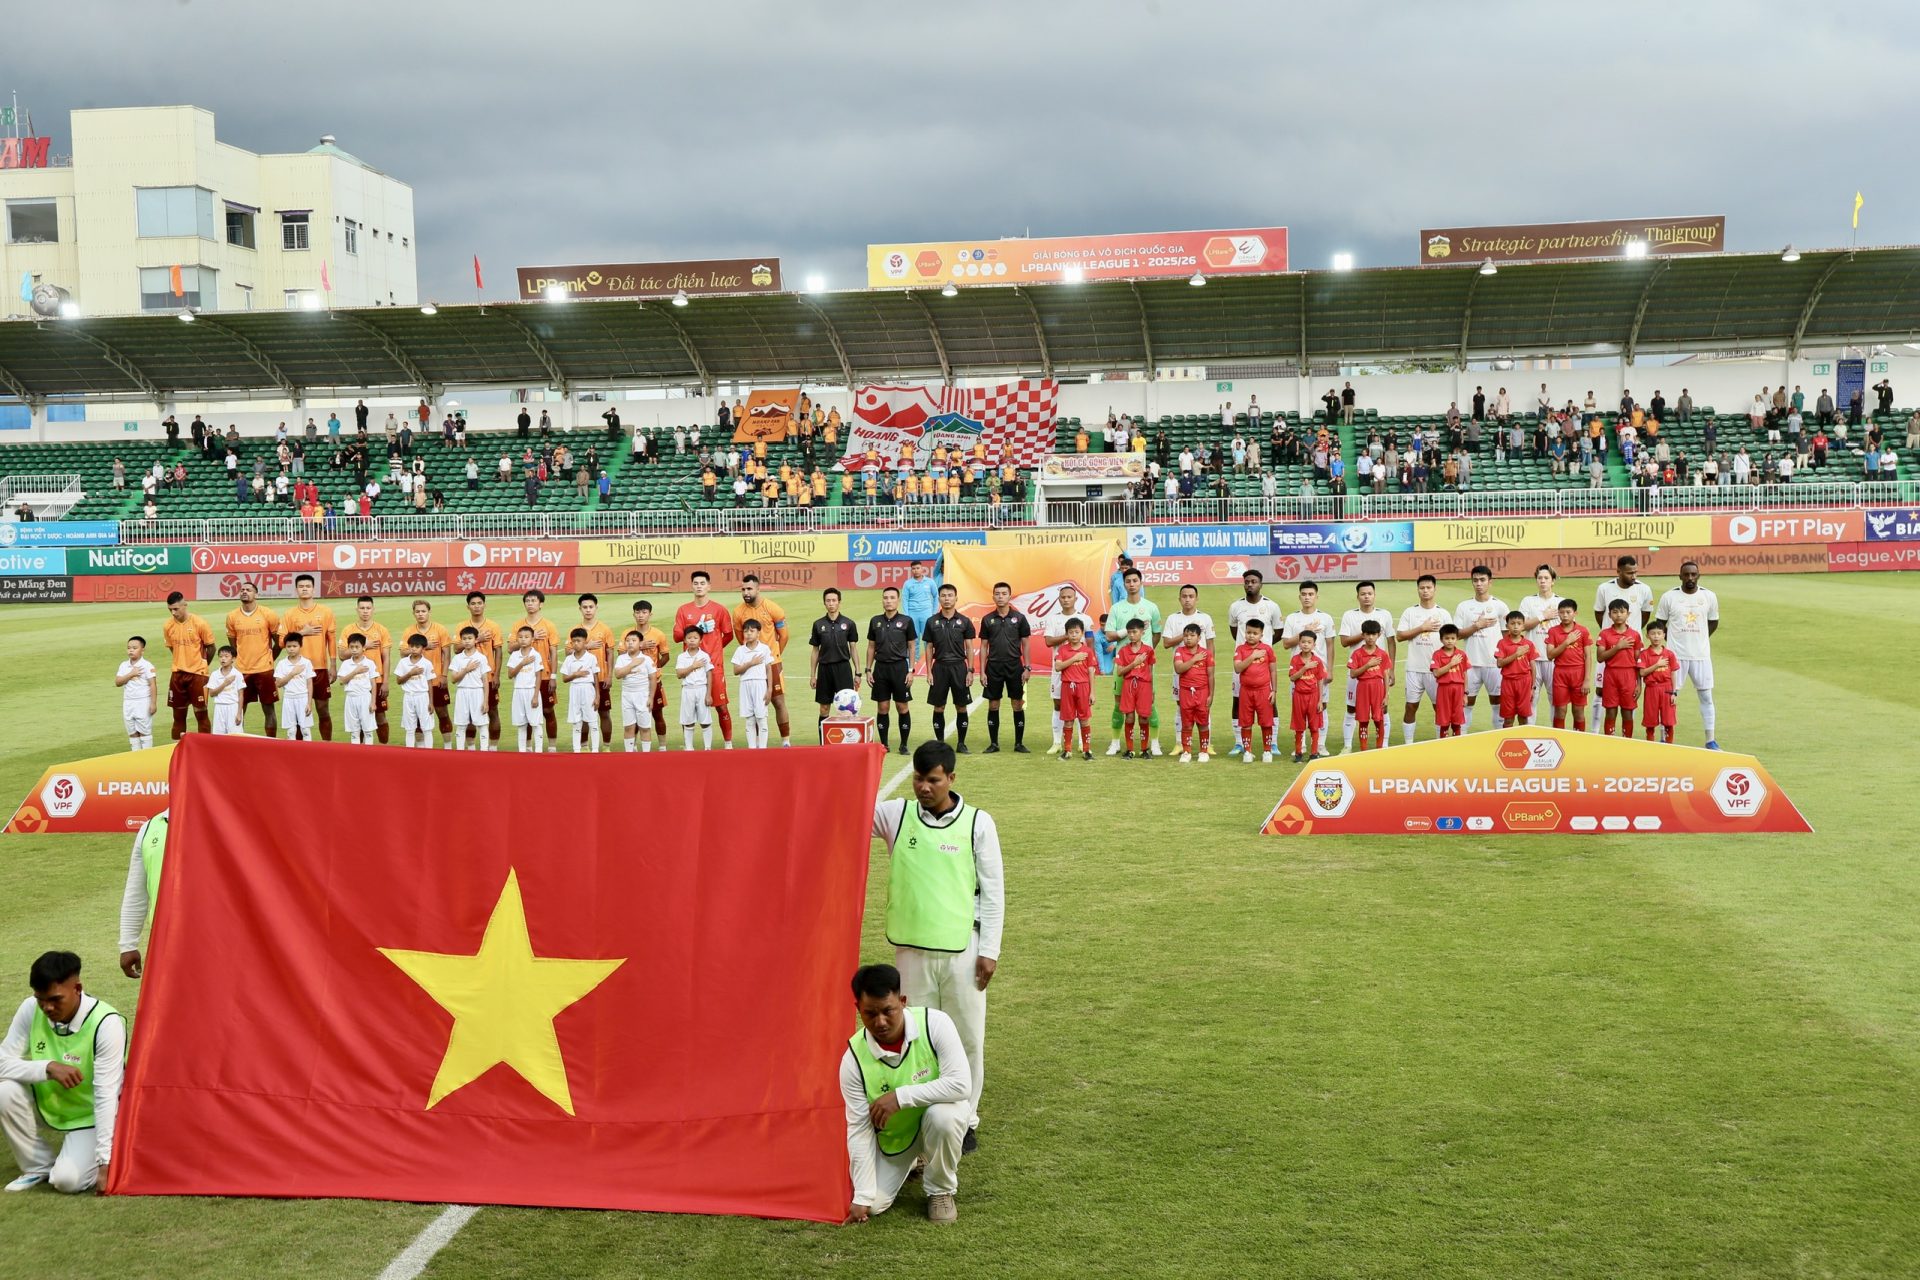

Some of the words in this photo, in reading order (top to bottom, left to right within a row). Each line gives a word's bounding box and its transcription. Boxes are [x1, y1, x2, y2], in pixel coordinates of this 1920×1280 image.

[1644, 225, 1716, 243] Thaigroup
[1083, 248, 1095, 257] ĐÁ
[1099, 247, 1111, 256] VÔ
[1115, 248, 1136, 256] ĐỊCH
[1139, 244, 1166, 255] QUỐC
[1168, 246, 1184, 254] GIA
[1459, 236, 1535, 255] Strategic
[1072, 258, 1130, 270] VLEAGUE
[1133, 258, 1139, 268] 1
[1148, 256, 1196, 267] 2025/26
[527, 278, 587, 294] LPBank
[606, 275, 637, 291] Đối
[640, 276, 662, 290] tác
[667, 273, 704, 289] chiến
[710, 272, 742, 289] lược
[854, 427, 899, 442] HOANG
[1156, 533, 1166, 548] XI
[1169, 529, 1199, 548] MĂNG
[1203, 528, 1231, 547] XUÂN
[1233, 527, 1267, 547] THÀNH
[1444, 521, 1525, 542] Thaigroup
[1592, 519, 1675, 540] Thaigroup
[1761, 520, 1799, 537] FPT
[1803, 519, 1846, 539] Play
[1896, 523, 1920, 535] BIA
[491, 548, 522, 563] FPT
[527, 546, 563, 566] Play
[606, 541, 681, 560] Thaigroup
[740, 539, 815, 557] Thaigroup
[89, 548, 168, 567] Nutifood
[360, 549, 392, 564] FPT
[397, 547, 432, 568] Play
[1186, 560, 1193, 570] 1
[1304, 554, 1358, 573] VPF
[1409, 555, 1507, 573] Thaigroup
[1552, 552, 1652, 570] Thaigrp
[1729, 550, 1774, 565] KHOÁN
[1777, 551, 1826, 564] LPBANK
[244, 573, 292, 591] VPF
[357, 570, 434, 579] SAVABECO
[480, 572, 565, 590] JOGARBOLA
[592, 568, 681, 587] Thaigroup
[881, 567, 911, 582] FPT
[1141, 573, 1180, 583] 25/26
[4, 580, 16, 588] De
[18, 579, 45, 590] Măng
[47, 580, 67, 588] Đen
[95, 583, 157, 599] LPBank
[345, 582, 369, 594] BIA
[372, 581, 402, 593] SAO
[403, 577, 446, 592] VÀNG
[98, 782, 169, 795] LPBANK
[1369, 778, 1458, 793] LPBANK
[1464, 778, 1570, 793] V.LEAGUE
[1576, 778, 1587, 793] 1
[1604, 777, 1694, 794] 2025/26
[54, 802, 72, 810] VPF
[1728, 800, 1750, 808] VPF
[1509, 813, 1545, 822] LPBank
